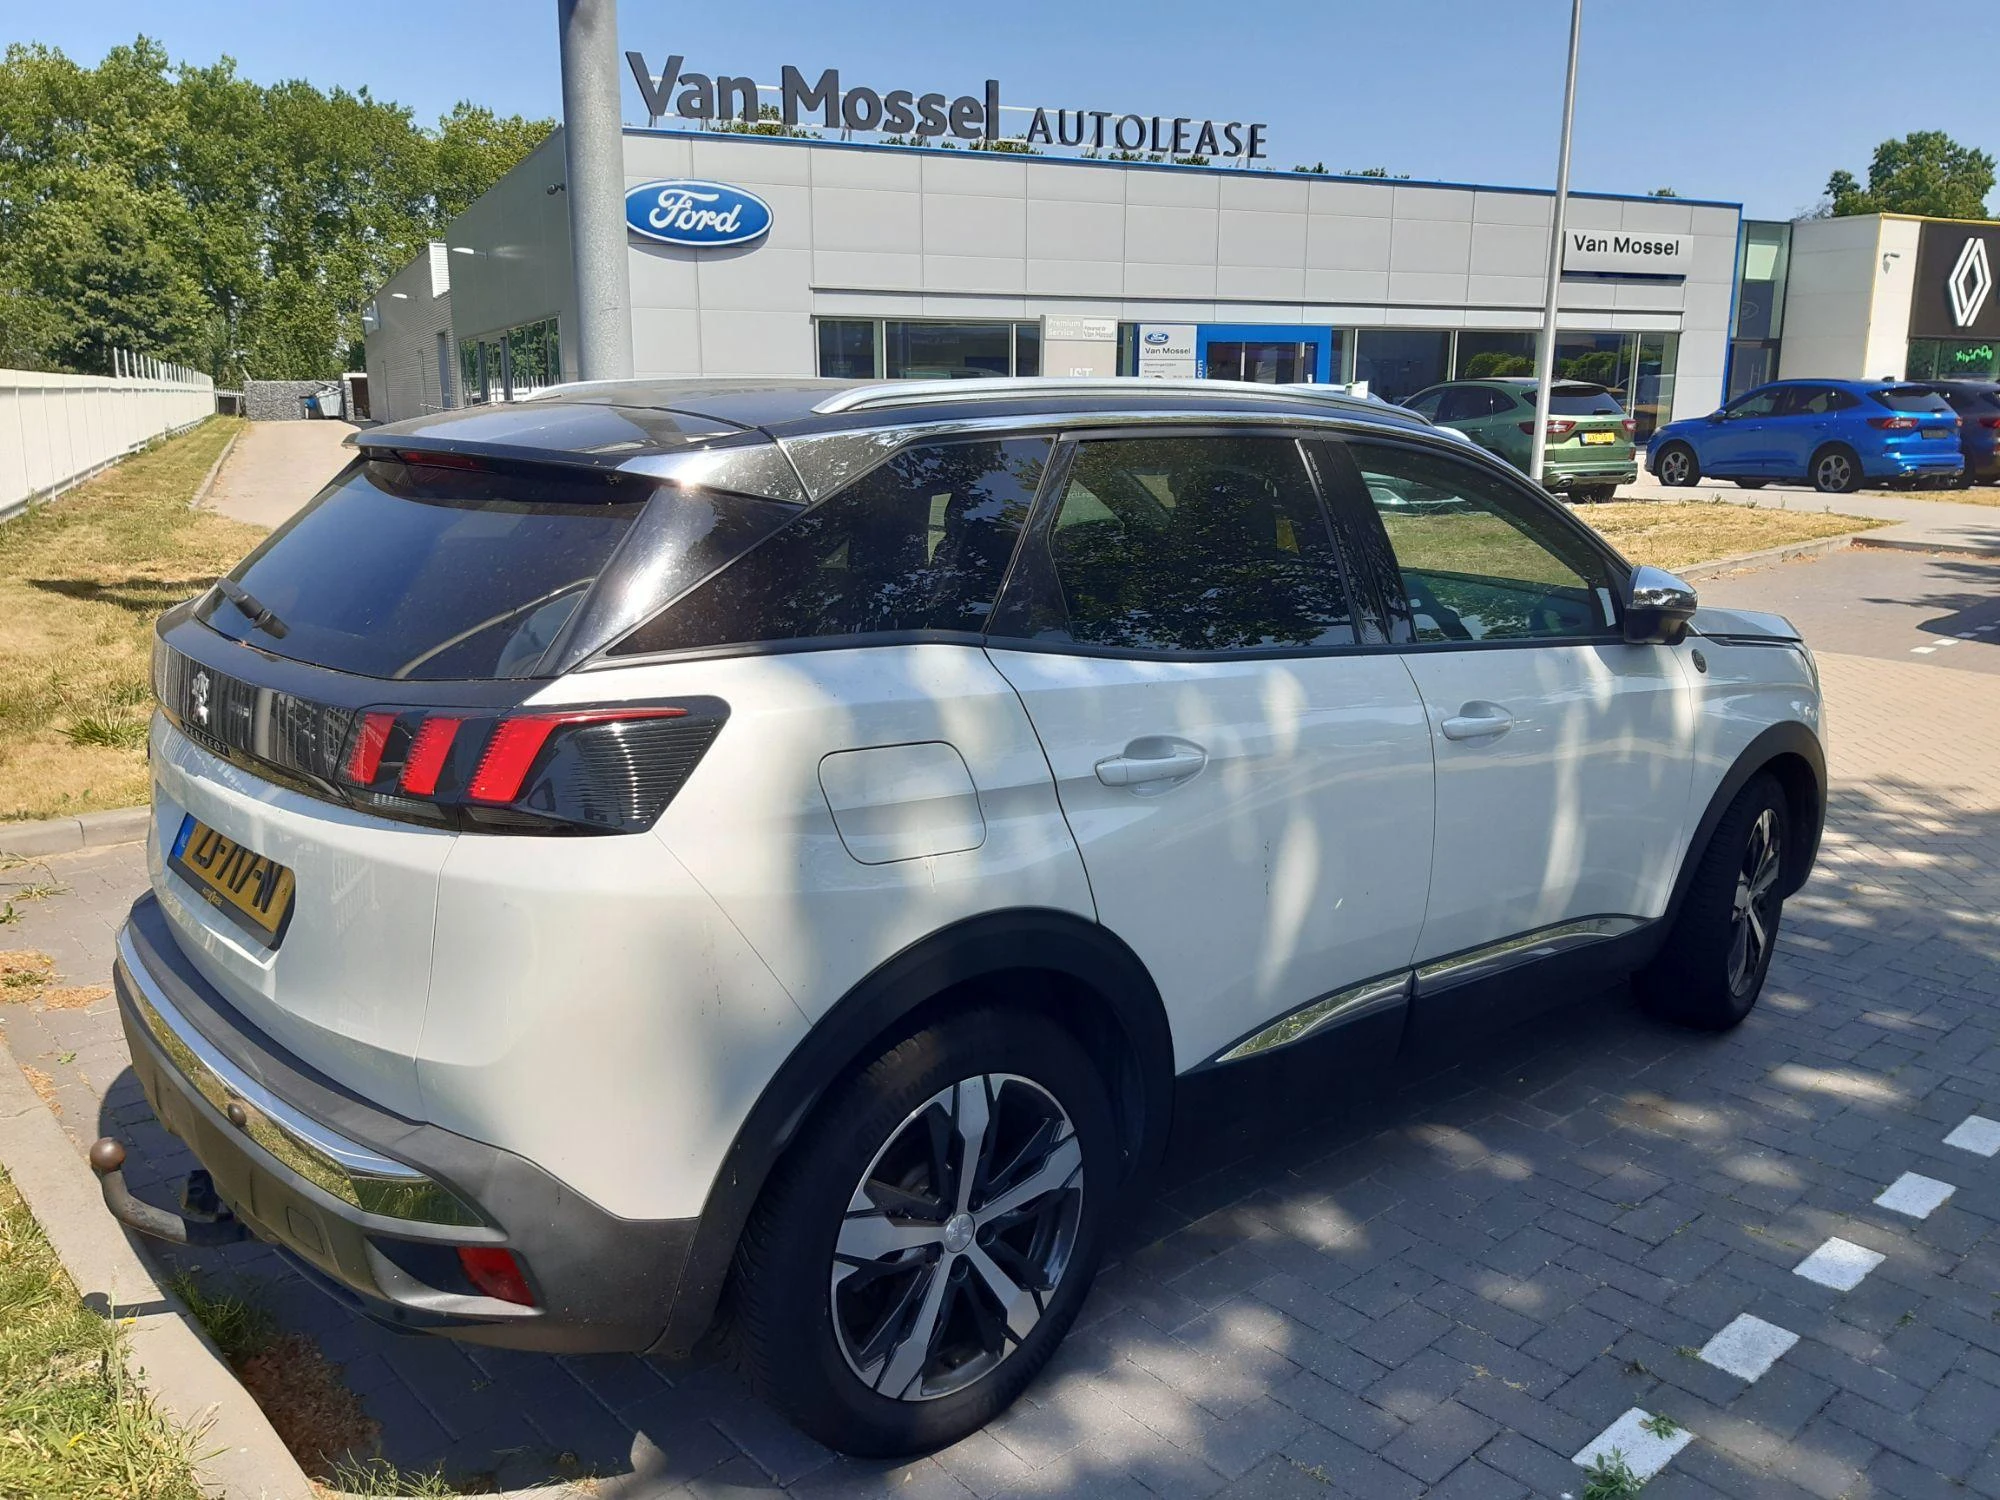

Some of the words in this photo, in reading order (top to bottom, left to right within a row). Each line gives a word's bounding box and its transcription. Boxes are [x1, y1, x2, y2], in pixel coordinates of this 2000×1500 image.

[625, 51, 758, 123] Van
[781, 64, 999, 141] Mossel
[1027, 106, 1268, 158] AUTOLEASE
[648, 187, 742, 234] Ford
[1573, 234, 1608, 253] Van
[1613, 235, 1680, 257] Mossel
[1162, 347, 1191, 355] Mossel
[183, 723, 228, 756] PEUGEOT
